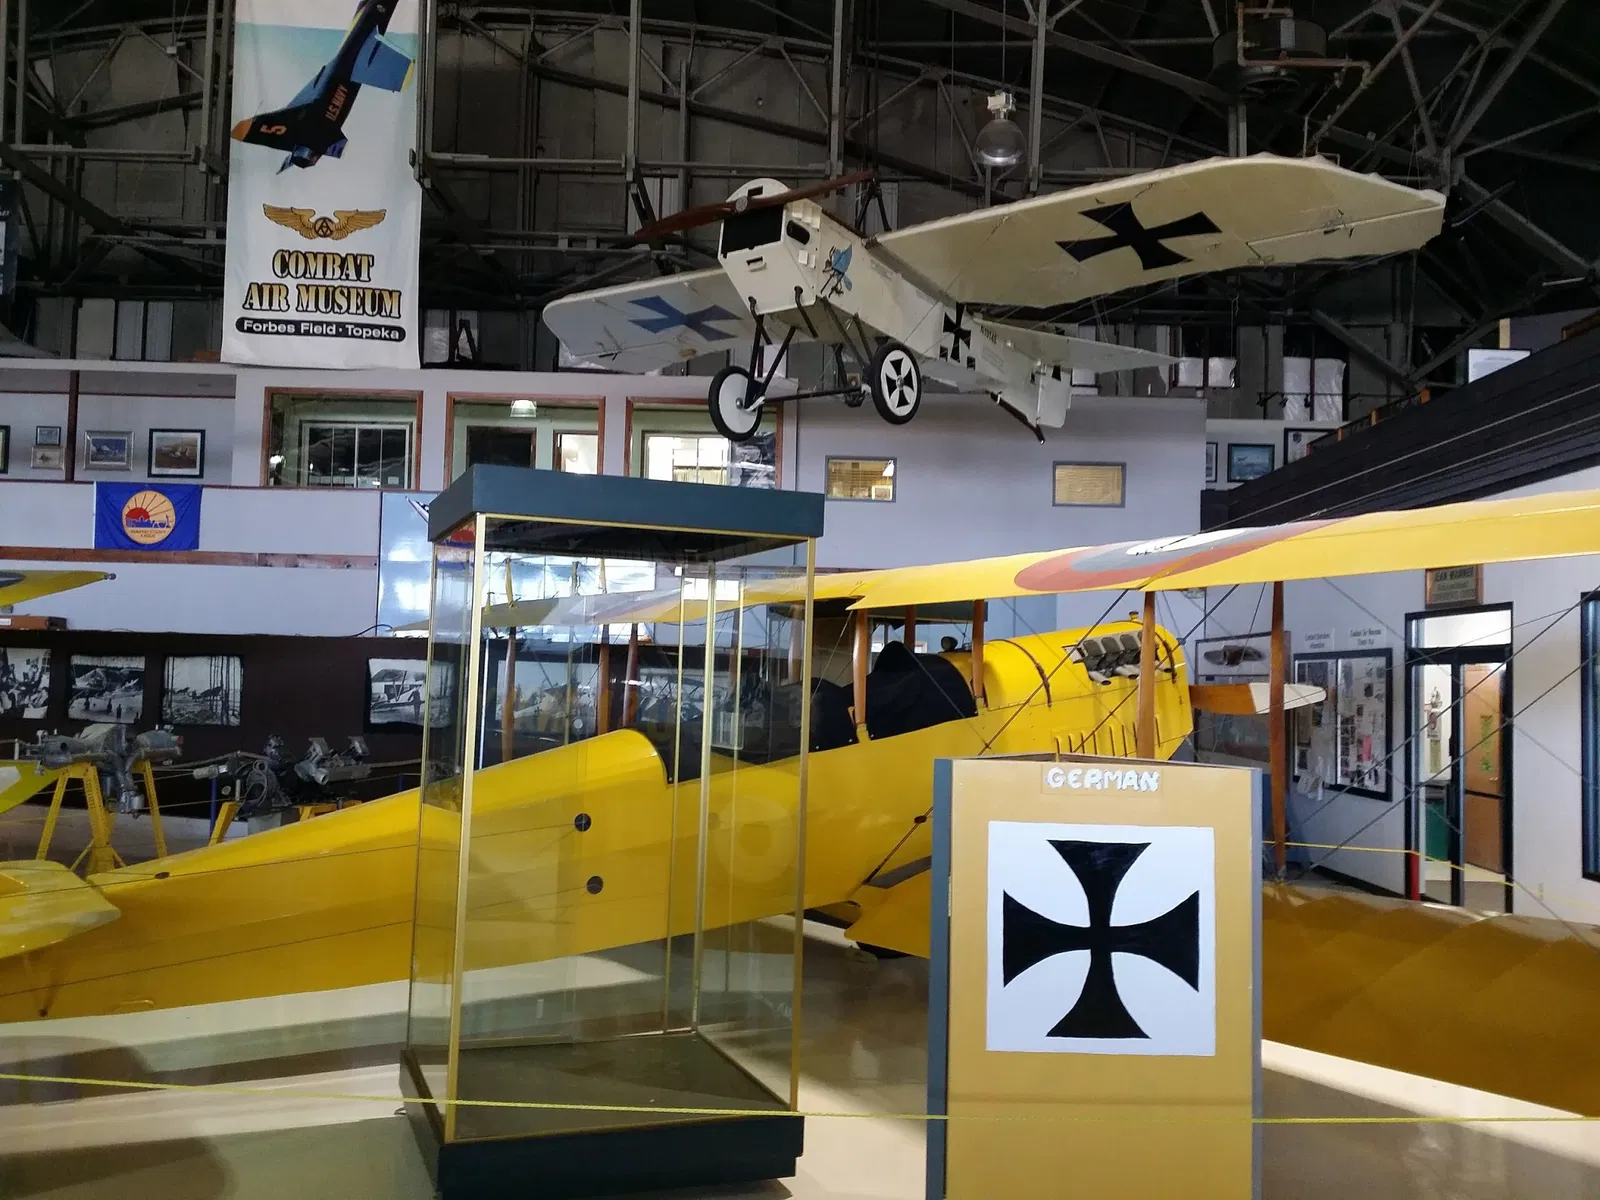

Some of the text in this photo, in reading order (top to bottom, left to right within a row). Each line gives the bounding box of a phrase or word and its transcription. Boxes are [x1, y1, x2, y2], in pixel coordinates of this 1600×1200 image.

[260, 124, 287, 136] 5
[272, 249, 374, 282] COMBAT
[242, 283, 402, 318] AIR MUSEUM
[243, 320, 399, 340] Forbes Field Topeka
[1047, 766, 1160, 792] GERMAN
